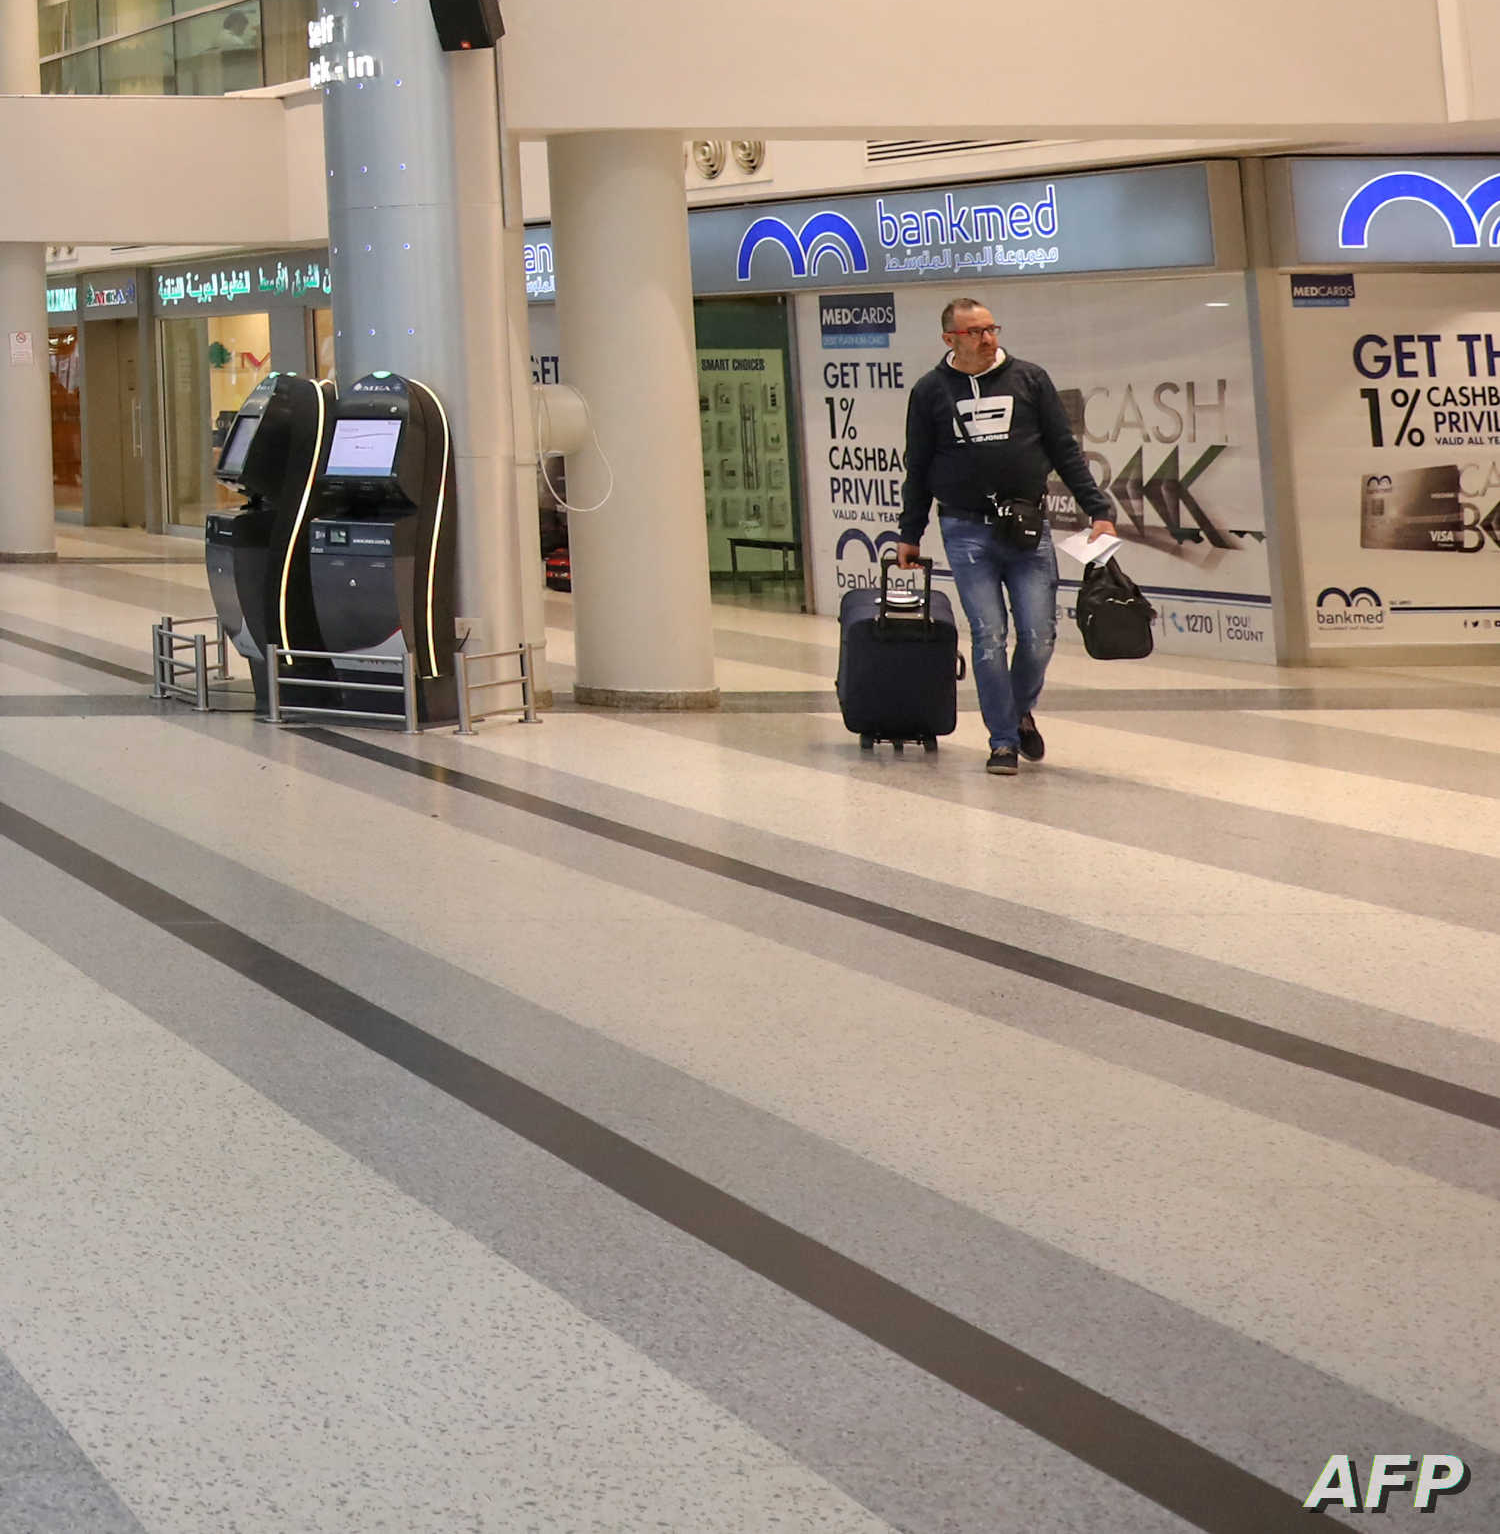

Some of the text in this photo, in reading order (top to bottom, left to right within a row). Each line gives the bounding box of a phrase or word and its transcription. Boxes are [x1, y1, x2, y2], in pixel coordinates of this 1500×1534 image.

[877, 184, 1058, 249] bankmed
[1293, 285, 1354, 297] MEDCARDS
[822, 306, 894, 326] MEDCARDS
[701, 358, 766, 371] SMART CHOICES
[1353, 334, 1441, 380] GET
[824, 362, 904, 389] GET THE
[825, 397, 857, 440] 1%
[1085, 379, 1228, 443] CASH
[1360, 388, 1425, 447] 1%
[1435, 437, 1464, 446] VALID
[1467, 438, 1485, 446] ALL
[829, 446, 906, 473] CASHBA
[833, 509, 857, 519] VALID
[861, 511, 875, 521] ALL
[1048, 496, 1077, 514] VISA
[1430, 530, 1454, 542] VISA
[1186, 613, 1213, 635] 1270
[1317, 610, 1384, 625] bankmed
[1227, 630, 1265, 643] COUNT
